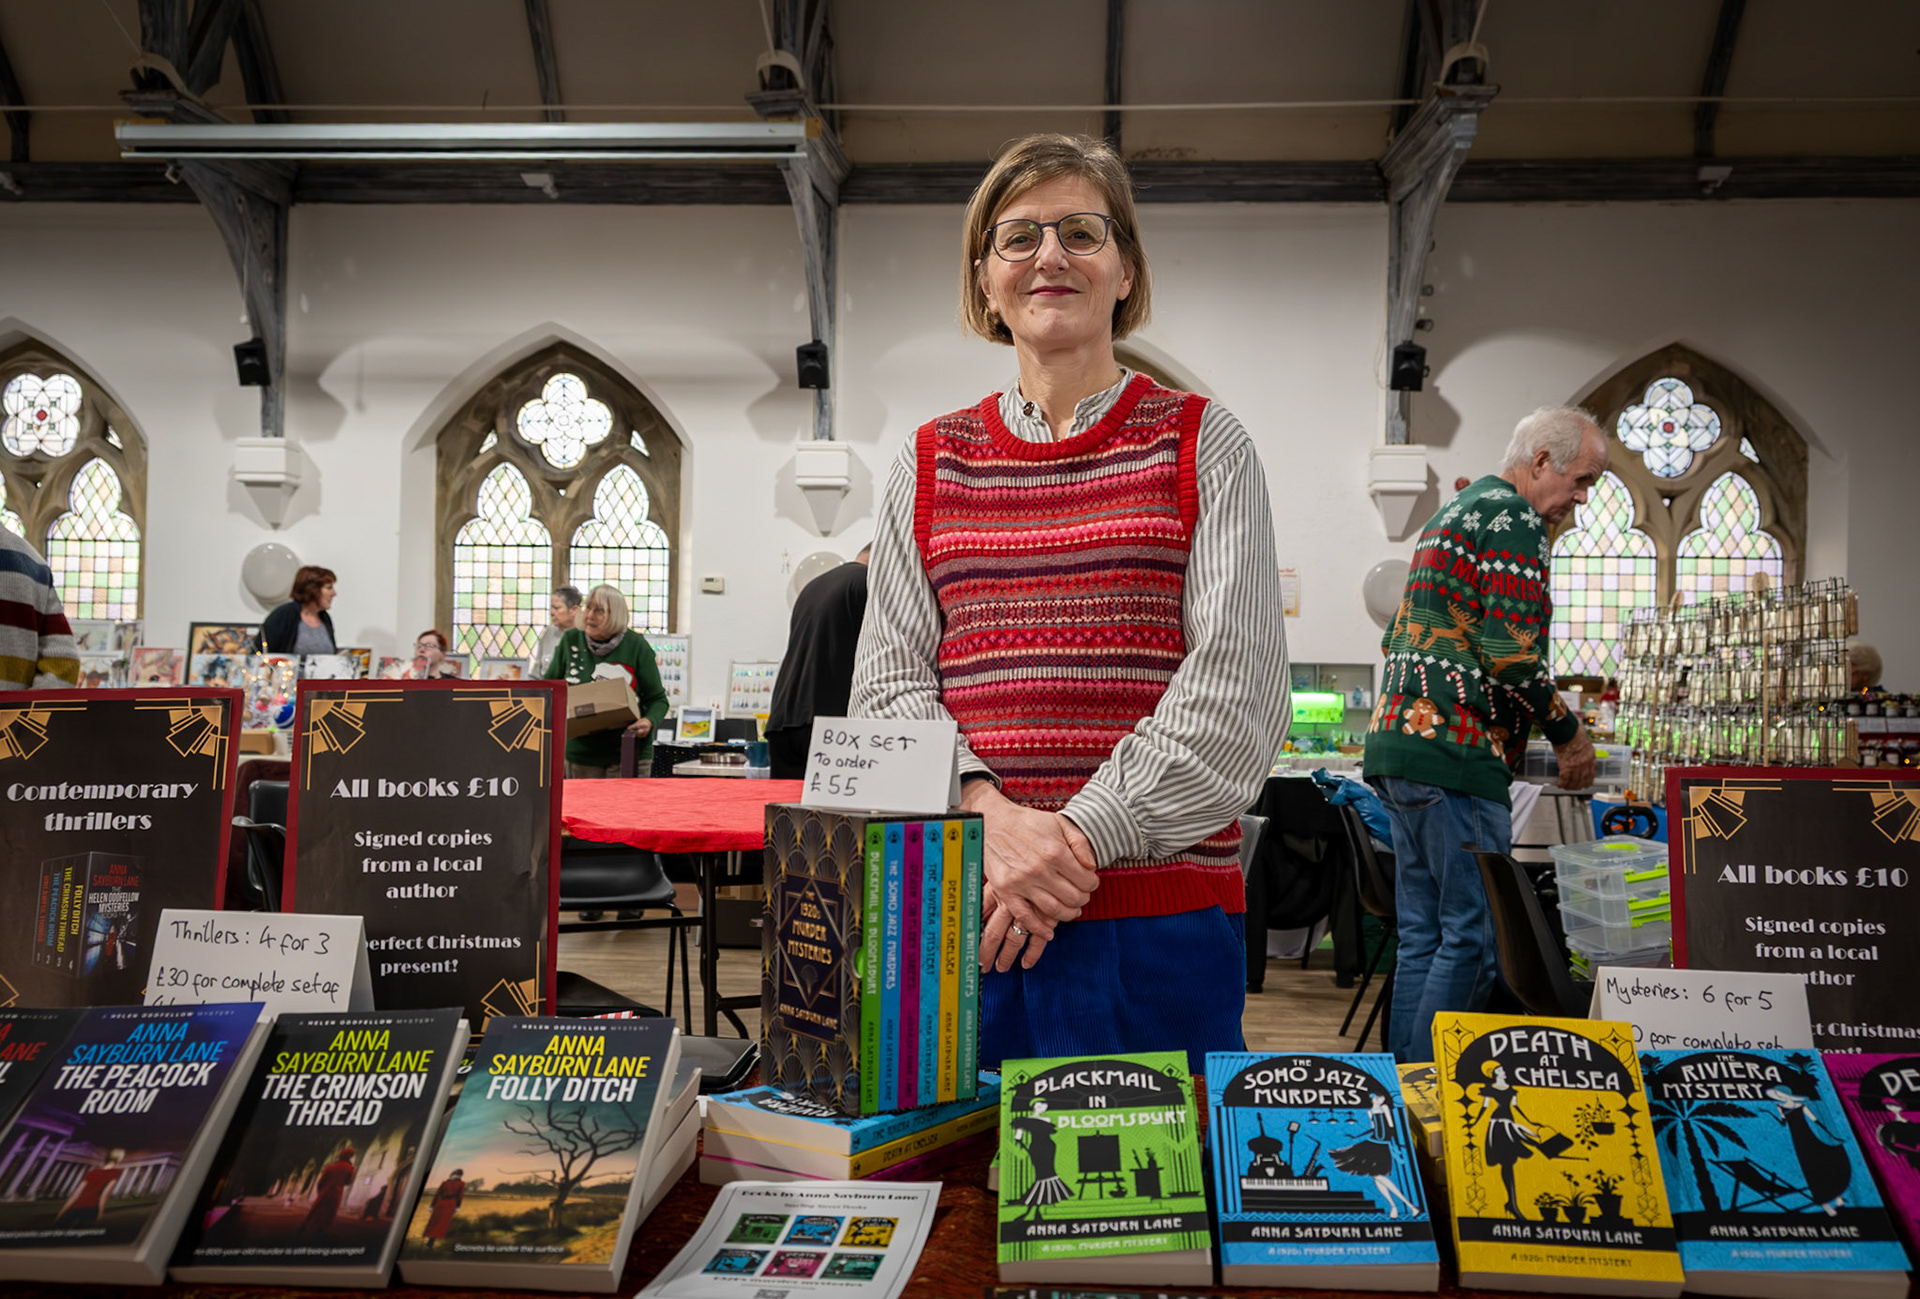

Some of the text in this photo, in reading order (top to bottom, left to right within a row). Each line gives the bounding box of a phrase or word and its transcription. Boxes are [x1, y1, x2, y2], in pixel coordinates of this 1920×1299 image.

[1480, 571, 1541, 601] CHRIST
[822, 728, 917, 751] BOX SET
[835, 754, 880, 770] order
[7, 781, 199, 801] Contemporary
[330, 776, 519, 798] All books £10
[810, 772, 859, 797] £55
[44, 812, 152, 831] thrillers
[354, 829, 493, 850] Signed copies
[362, 856, 483, 873] from a local
[1717, 864, 1909, 888] All books £10
[60, 883, 71, 921] CRIMSON
[386, 883, 458, 899] author
[70, 884, 84, 935] FOLLY DITCH
[99, 902, 130, 913] MYSTERIES
[170, 919, 330, 955] Thrillers: 4 for 3
[791, 919, 827, 943] MURDER
[1745, 916, 1887, 937] Signed copies
[426, 934, 521, 949] Christmas
[787, 939, 833, 965] MYSTERIES
[1755, 943, 1879, 961] from a local
[380, 959, 459, 977] present!
[1804, 970, 1856, 986] thor
[156, 966, 189, 988] £30
[193, 973, 218, 996] for
[221, 970, 285, 1002] complete
[1606, 977, 1774, 1012] Mysteries: 6 for 5
[126, 1022, 189, 1044] ANNA
[329, 1029, 391, 1052] ANNA
[1650, 1031, 1677, 1050] for
[0, 1042, 48, 1061] ANE
[66, 1040, 229, 1065] SAYBURN LANE
[544, 1034, 606, 1056] ANNA
[1489, 1030, 1593, 1062] DEATH
[271, 1050, 434, 1073] SAYBURN LANE
[488, 1053, 651, 1078] SAYBURN LANE
[1292, 1059, 1312, 1067] THE
[1539, 1055, 1560, 1067] AT
[1715, 1054, 1736, 1062] THE
[53, 1062, 218, 1090] THE PEACOCK
[1243, 1066, 1369, 1092] SOHO JAZZ
[1513, 1067, 1621, 1091] CHELSEA
[1681, 1061, 1783, 1083] RIVIERA
[262, 1073, 427, 1100] THE CRIMSON
[486, 1075, 638, 1103] FOLLY DITCH
[1034, 1070, 1161, 1097] BLACKMAIL
[1662, 1083, 1764, 1099] MYSTERY
[78, 1088, 160, 1114] ROOM
[1088, 1096, 1106, 1108] IN
[1254, 1088, 1362, 1105] MURDERS
[285, 1100, 383, 1126] THREAD
[1058, 1109, 1187, 1129] BLOOMSBURY
[1026, 1217, 1182, 1236] ANNA SAYBURN LANE
[1251, 1226, 1404, 1239] ANNA SAYBURN LANE
[1492, 1224, 1644, 1245] ANNA SAYBURN LANE
[1709, 1225, 1861, 1239] ANNA SAYBURN LANE
[1546, 1254, 1585, 1265] MURDER
[1588, 1256, 1633, 1268] MYSTERY
